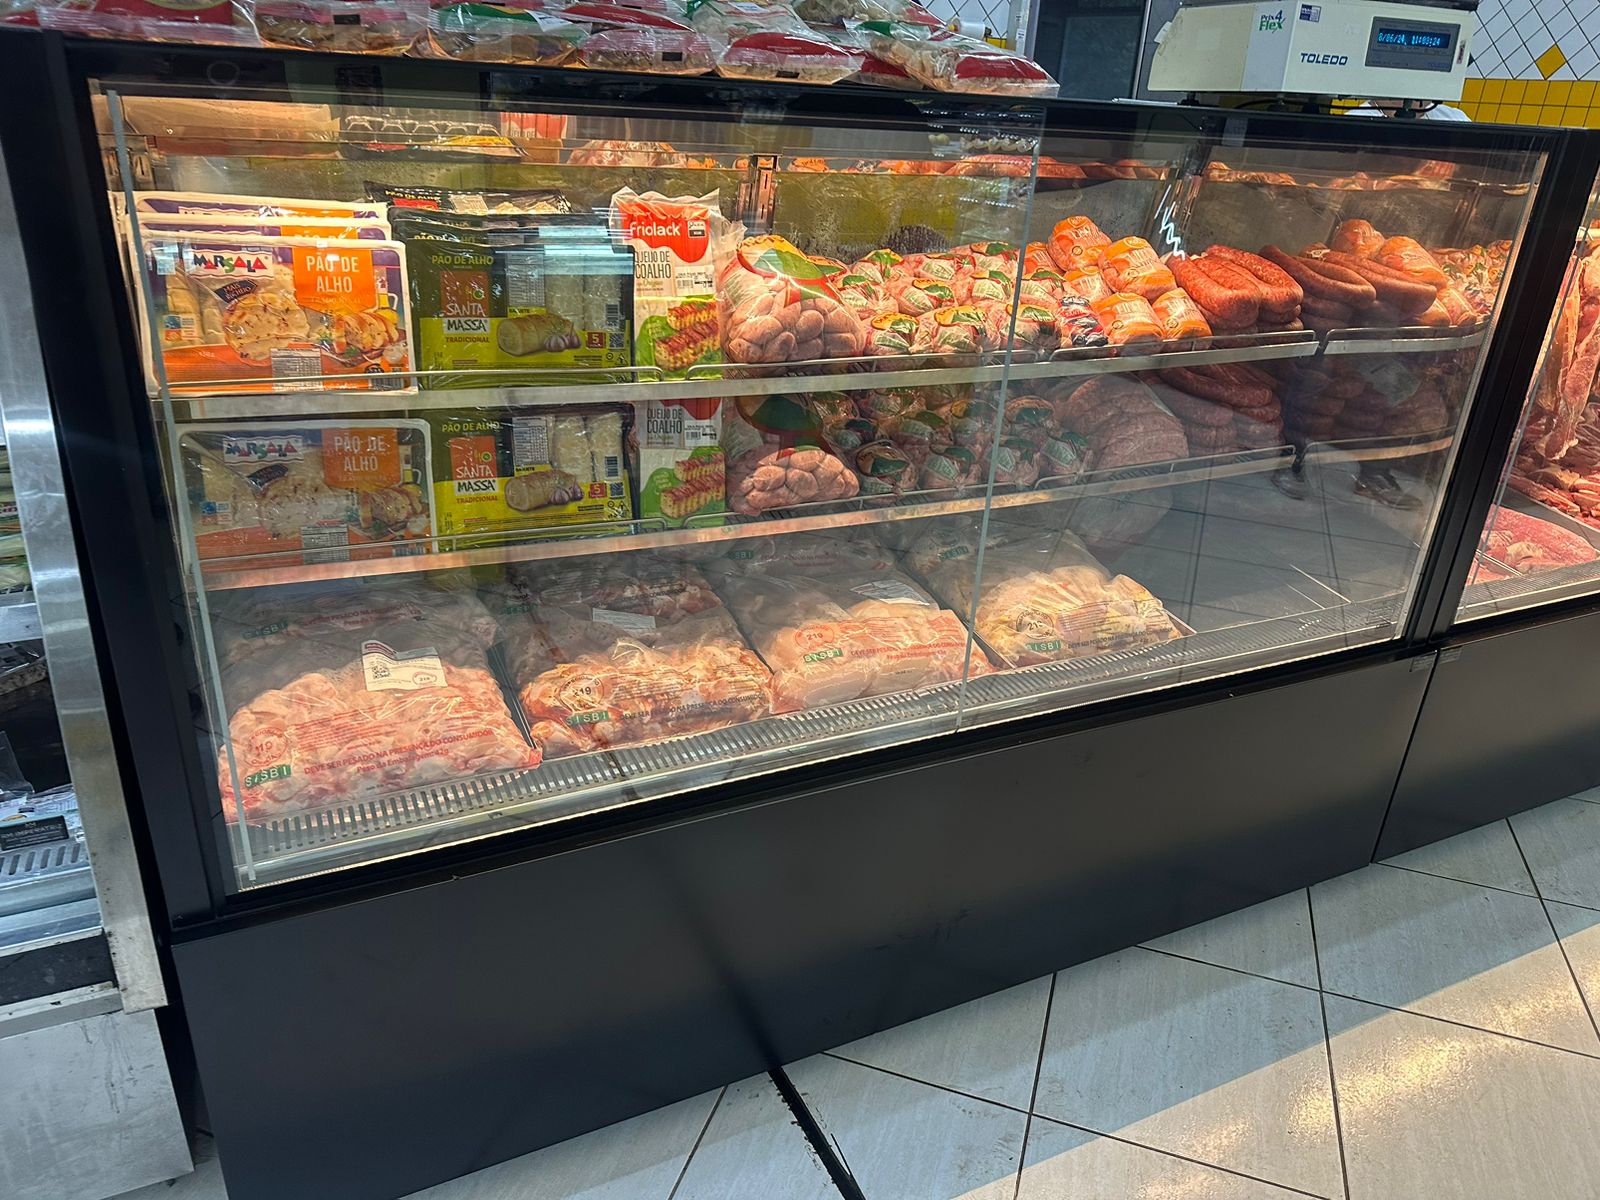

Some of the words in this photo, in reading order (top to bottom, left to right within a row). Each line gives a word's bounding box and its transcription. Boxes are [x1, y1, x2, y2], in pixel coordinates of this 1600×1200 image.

[1275, 9, 1283, 21] 4
[1259, 18, 1285, 33] Flex
[1300, 52, 1348, 66] TOLEDO
[193, 253, 268, 273] MARSALA
[306, 251, 334, 273] PÃO
[340, 256, 360, 273] DE
[431, 252, 453, 265] PÃO
[454, 254, 467, 264] DE
[468, 255, 494, 265] ALHO
[659, 250, 670, 263] DE
[635, 263, 672, 279] COALHO
[316, 275, 353, 293] ALHO
[446, 301, 487, 317] SANTA
[447, 319, 487, 332] MASSA
[446, 336, 490, 344] TRADICIONAL
[592, 333, 600, 344] 5
[647, 408, 671, 420] QUEIJO
[672, 408, 683, 420] DE
[442, 421, 461, 433] PÃO
[462, 422, 475, 431] DE
[647, 420, 683, 434] COALHO
[334, 432, 361, 453] PÃO
[367, 435, 386, 452] DE
[344, 455, 379, 472] ALHO
[456, 464, 494, 479] SANTA
[457, 479, 495, 492] MASSA
[594, 483, 601, 493] 5
[456, 495, 498, 504] TRADICIONAL
[566, 711, 607, 726] SISBI
[303, 761, 326, 775] DEVE
[326, 759, 342, 770] SER
[342, 753, 374, 766] PESADO
[377, 750, 389, 760] NA
